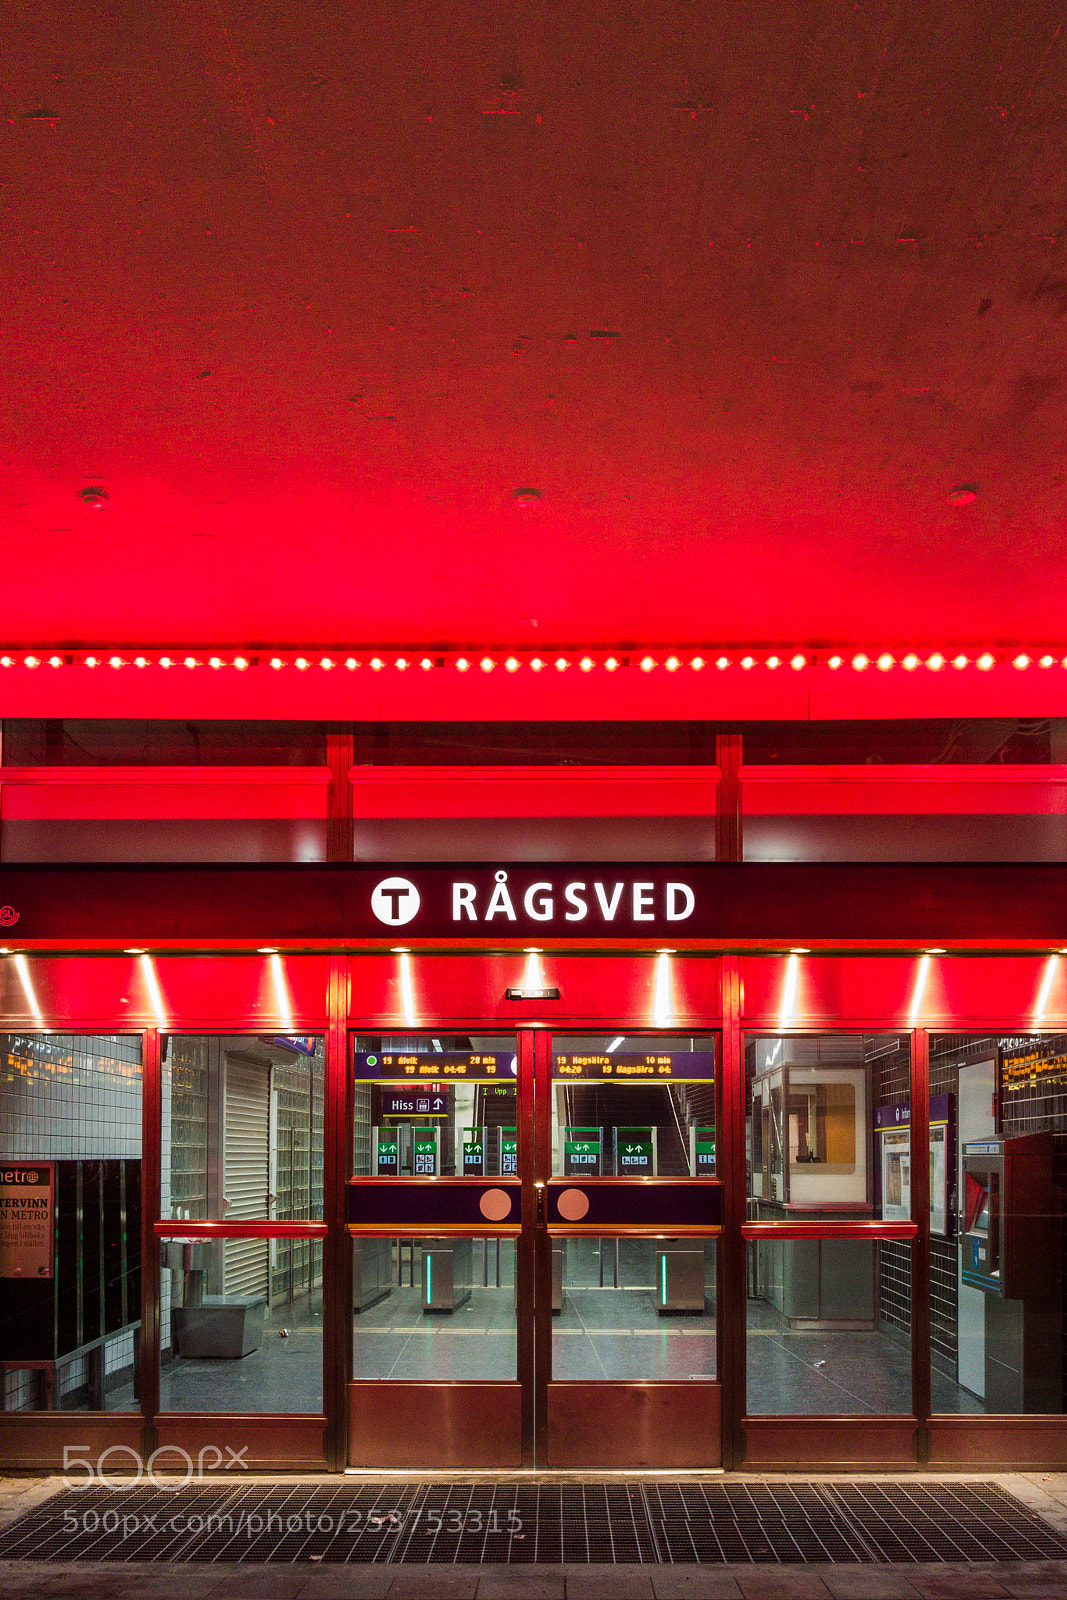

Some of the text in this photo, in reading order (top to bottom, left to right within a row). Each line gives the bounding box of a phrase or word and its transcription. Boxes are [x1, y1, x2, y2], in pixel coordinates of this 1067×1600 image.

[452, 870, 696, 921] RÅGSVED
[383, 1056, 392, 1065] 19
[398, 1056, 418, 1065] Alvik
[482, 1056, 496, 1065] min
[556, 1056, 567, 1065] 19
[645, 1056, 656, 1065] 10
[657, 1056, 671, 1065] min
[494, 1087, 507, 1096] Upp
[391, 1100, 414, 1111] Hiss
[0, 1169, 39, 1183] etro
[11, 1210, 49, 1220] METRO
